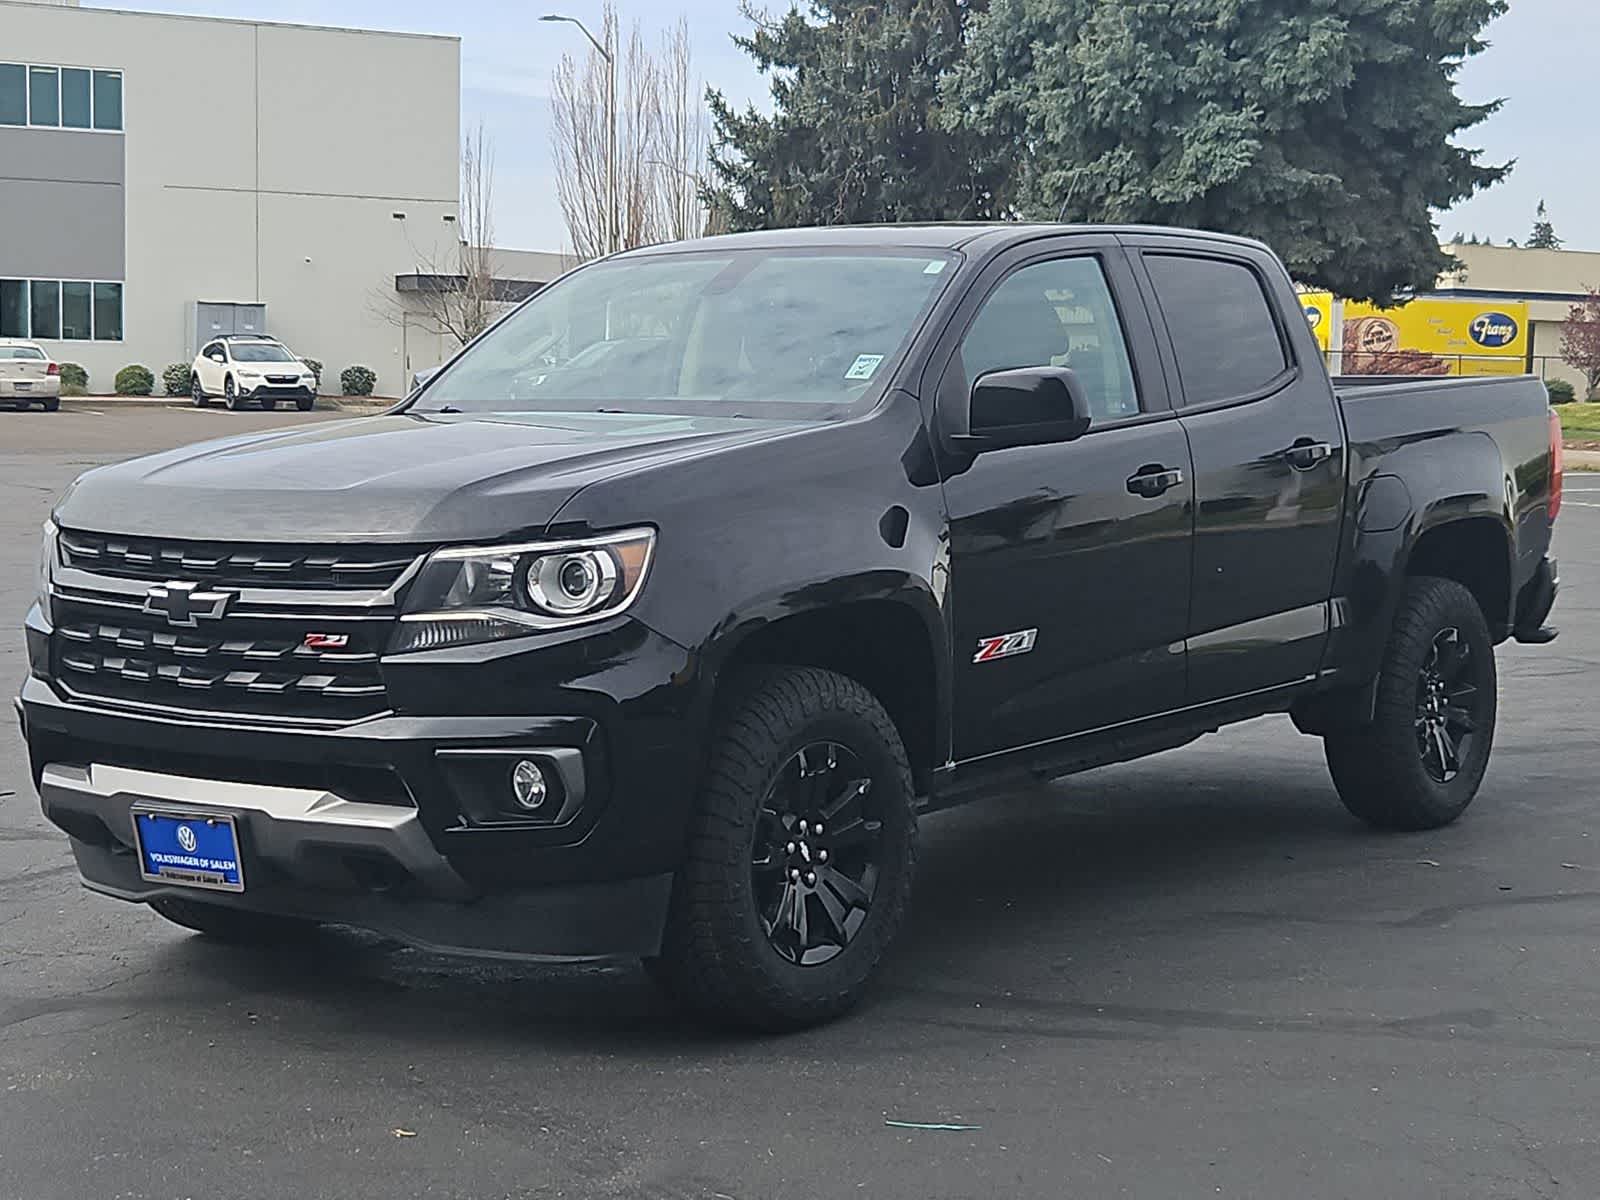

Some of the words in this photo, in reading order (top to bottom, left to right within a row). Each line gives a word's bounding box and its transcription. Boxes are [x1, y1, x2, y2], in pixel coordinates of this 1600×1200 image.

[1473, 316, 1513, 343] Franz
[303, 633, 349, 647] Z71
[972, 628, 1038, 663] Z71
[150, 852, 199, 867] VOLKSWAGEN
[199, 858, 209, 868] OF
[209, 859, 236, 870] SALEM
